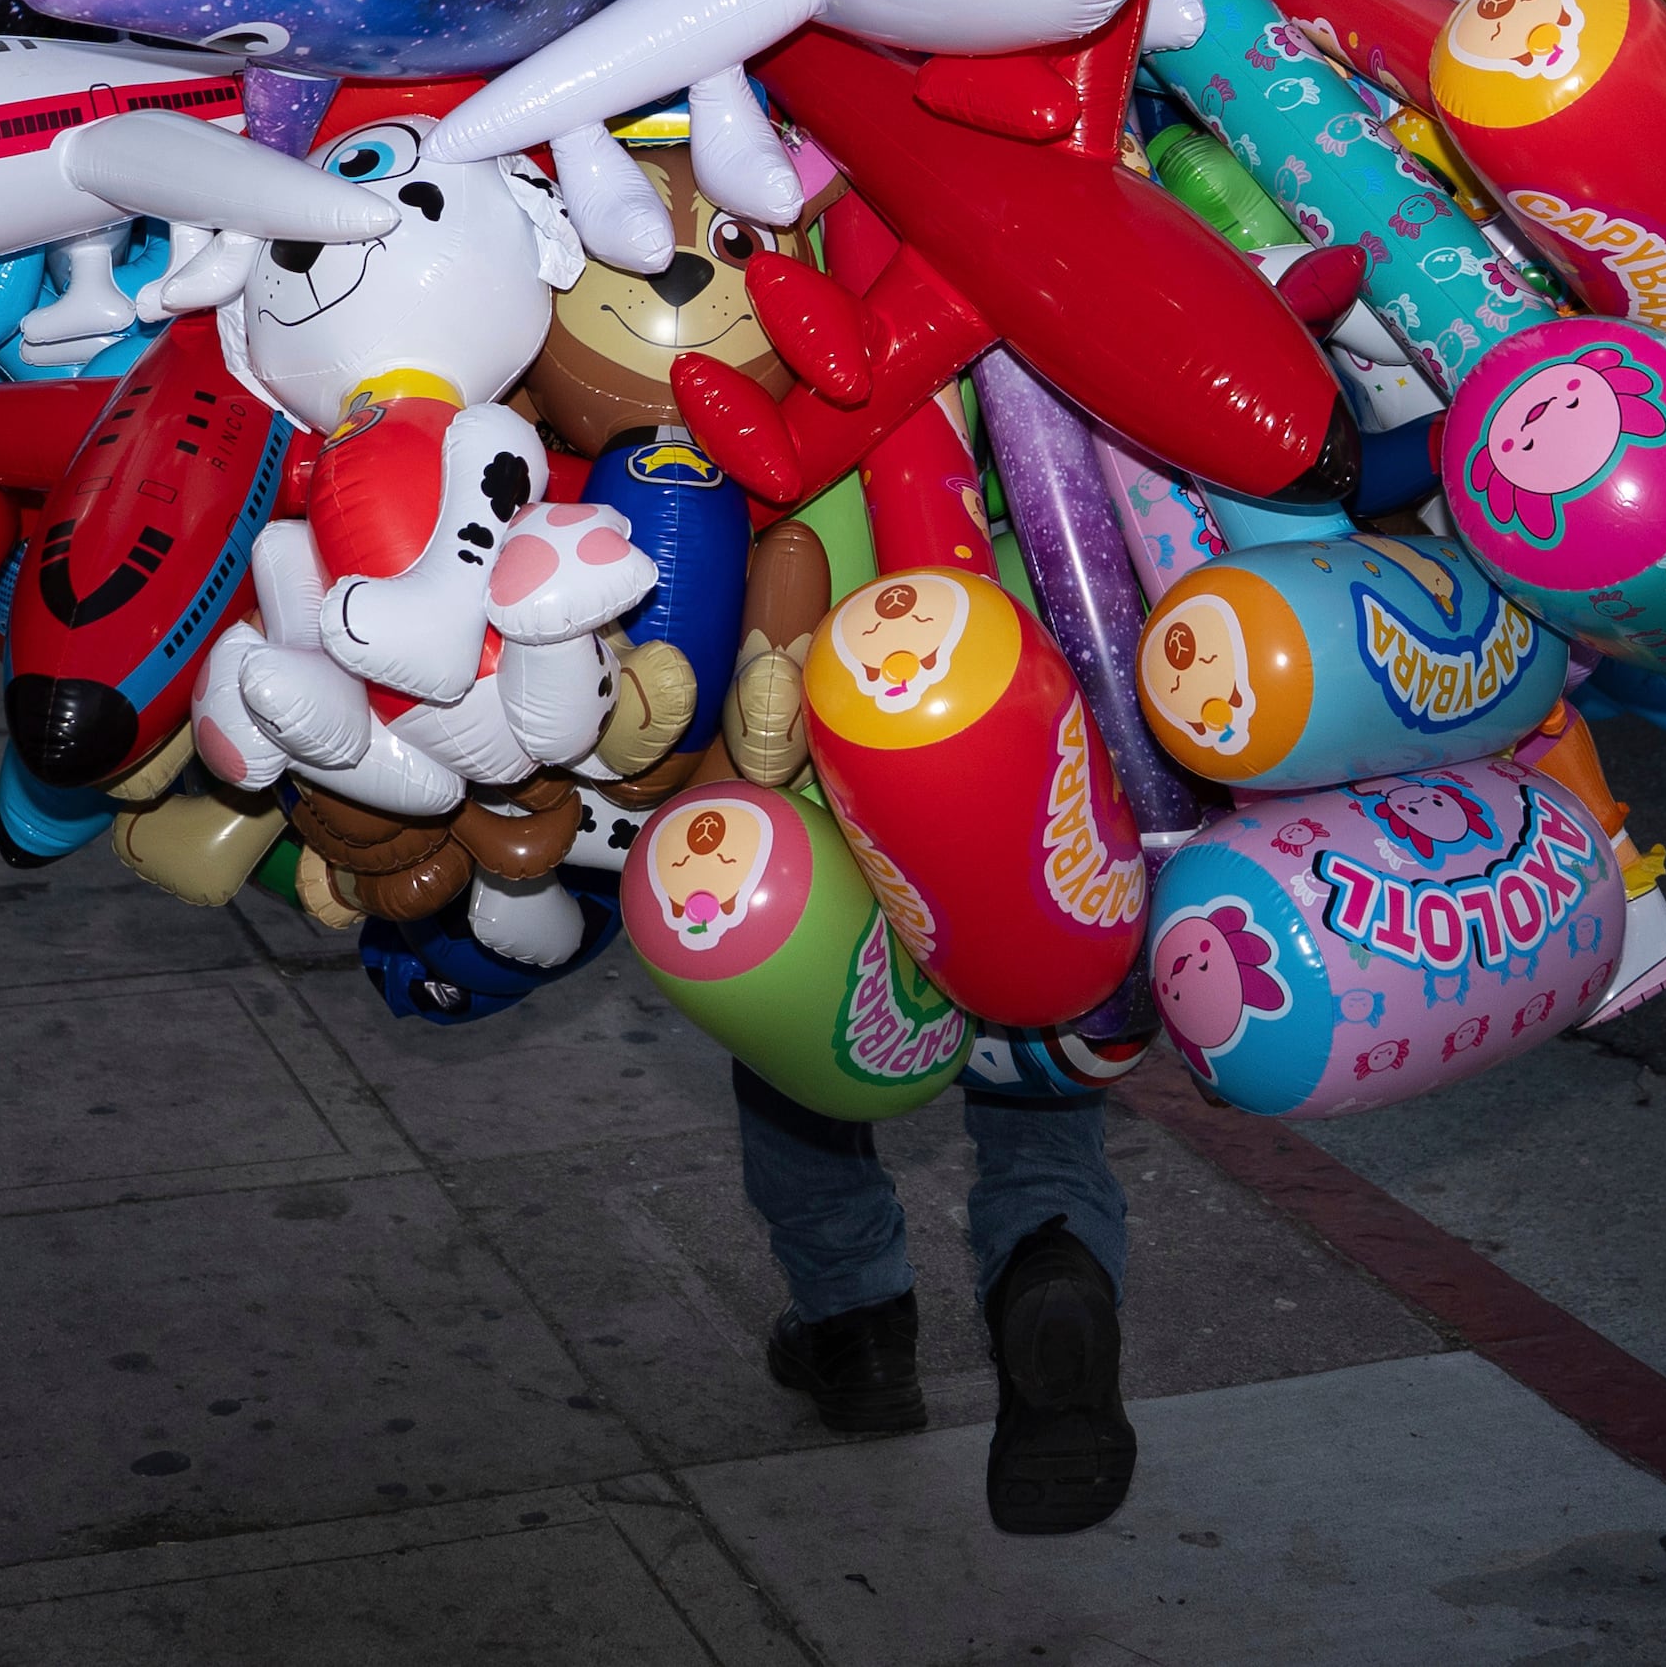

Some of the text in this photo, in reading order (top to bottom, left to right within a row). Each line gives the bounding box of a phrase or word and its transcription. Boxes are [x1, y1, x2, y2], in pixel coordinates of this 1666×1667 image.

[210, 402, 247, 473] RINCO
[1369, 600, 1531, 715] CAPYBARA
[1049, 702, 1146, 921] CAPYBARA
[1329, 794, 1589, 965] AXOLOTL
[851, 916, 966, 1075] CAPYBARA
